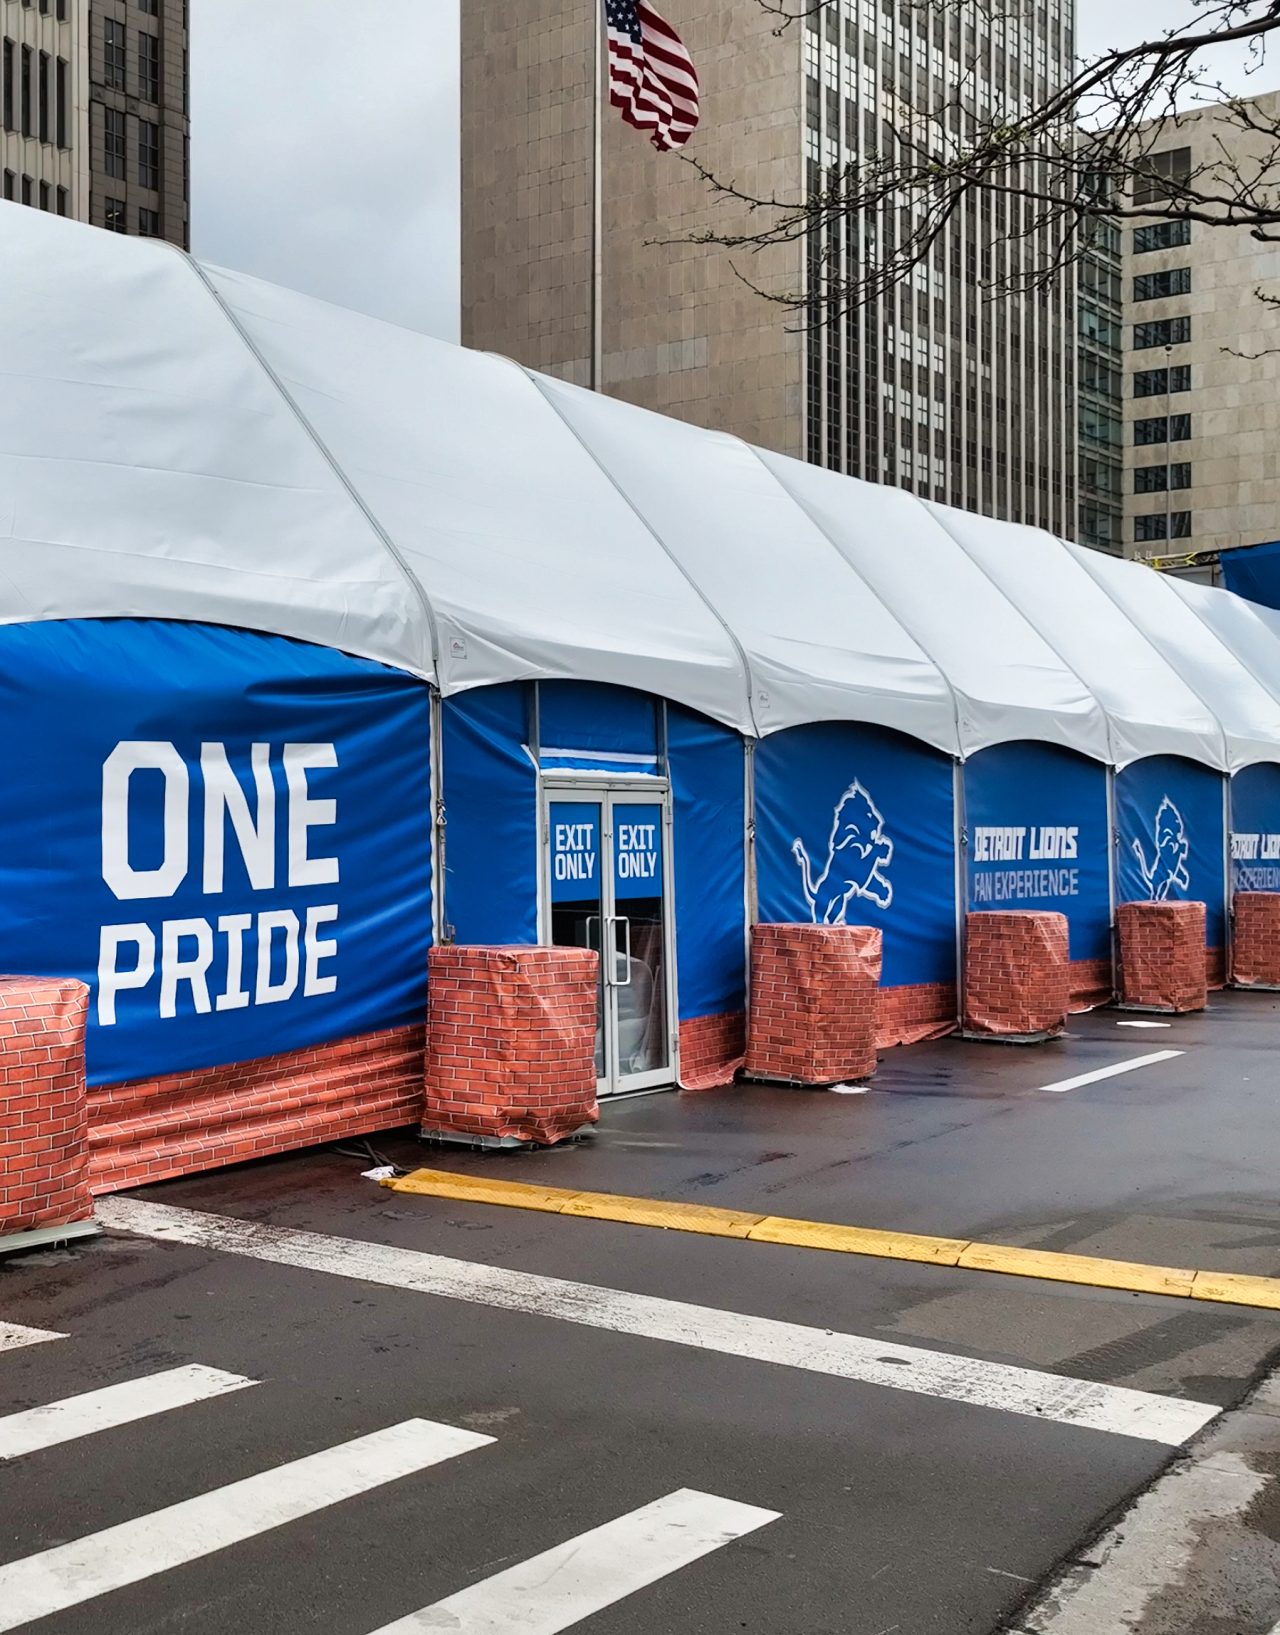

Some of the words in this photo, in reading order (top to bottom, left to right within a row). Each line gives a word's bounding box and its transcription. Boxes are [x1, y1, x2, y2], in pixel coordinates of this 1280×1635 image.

[102, 740, 340, 901] ONE
[555, 823, 594, 851] EXIT
[618, 824, 655, 850] EXIT
[973, 826, 1026, 862] DETROIT
[1029, 826, 1079, 860] LIONS
[555, 852, 596, 881] ONLY
[619, 851, 657, 879] ONLY
[974, 871, 993, 903] FAN
[994, 868, 1080, 901] EXPERIENCE
[97, 904, 339, 1026] PRIDE
